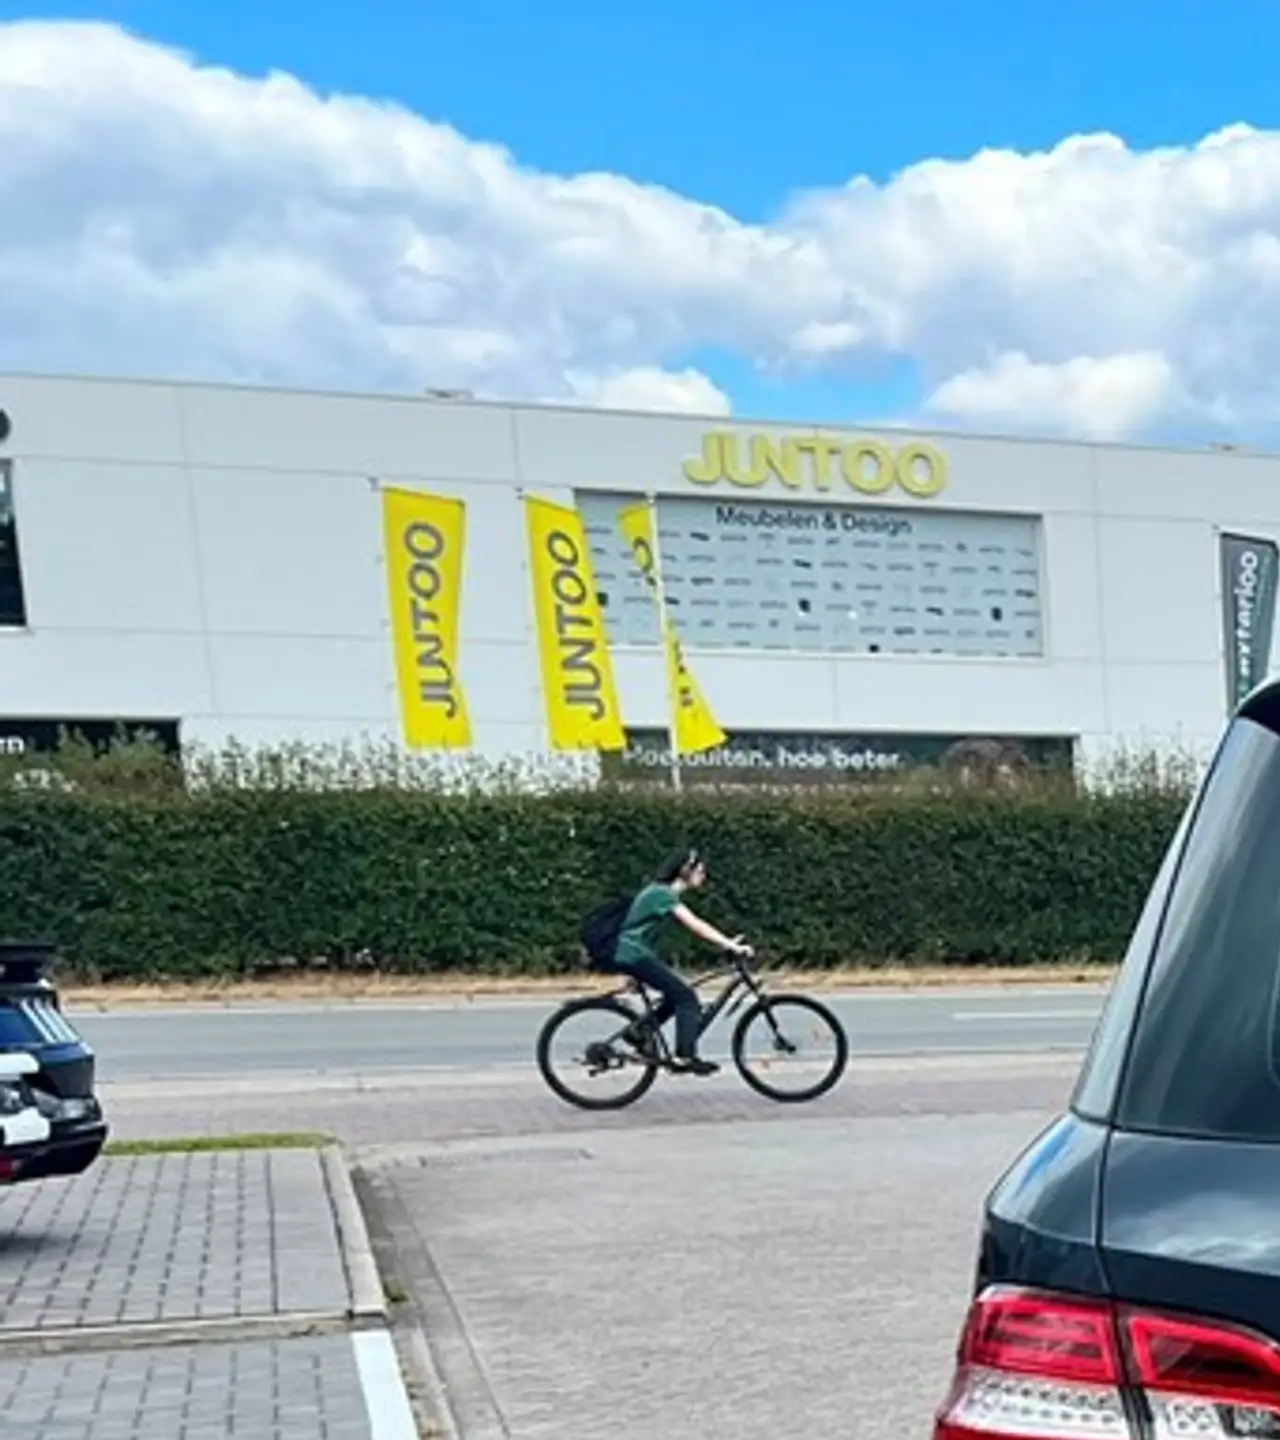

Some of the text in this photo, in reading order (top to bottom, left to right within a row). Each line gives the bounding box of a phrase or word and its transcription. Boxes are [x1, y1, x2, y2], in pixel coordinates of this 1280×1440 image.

[683, 429, 948, 497] JUNTOO
[716, 505, 913, 538] Meubelen & Design
[404, 521, 457, 719] JUNTOO
[547, 529, 606, 721] JUNTOO
